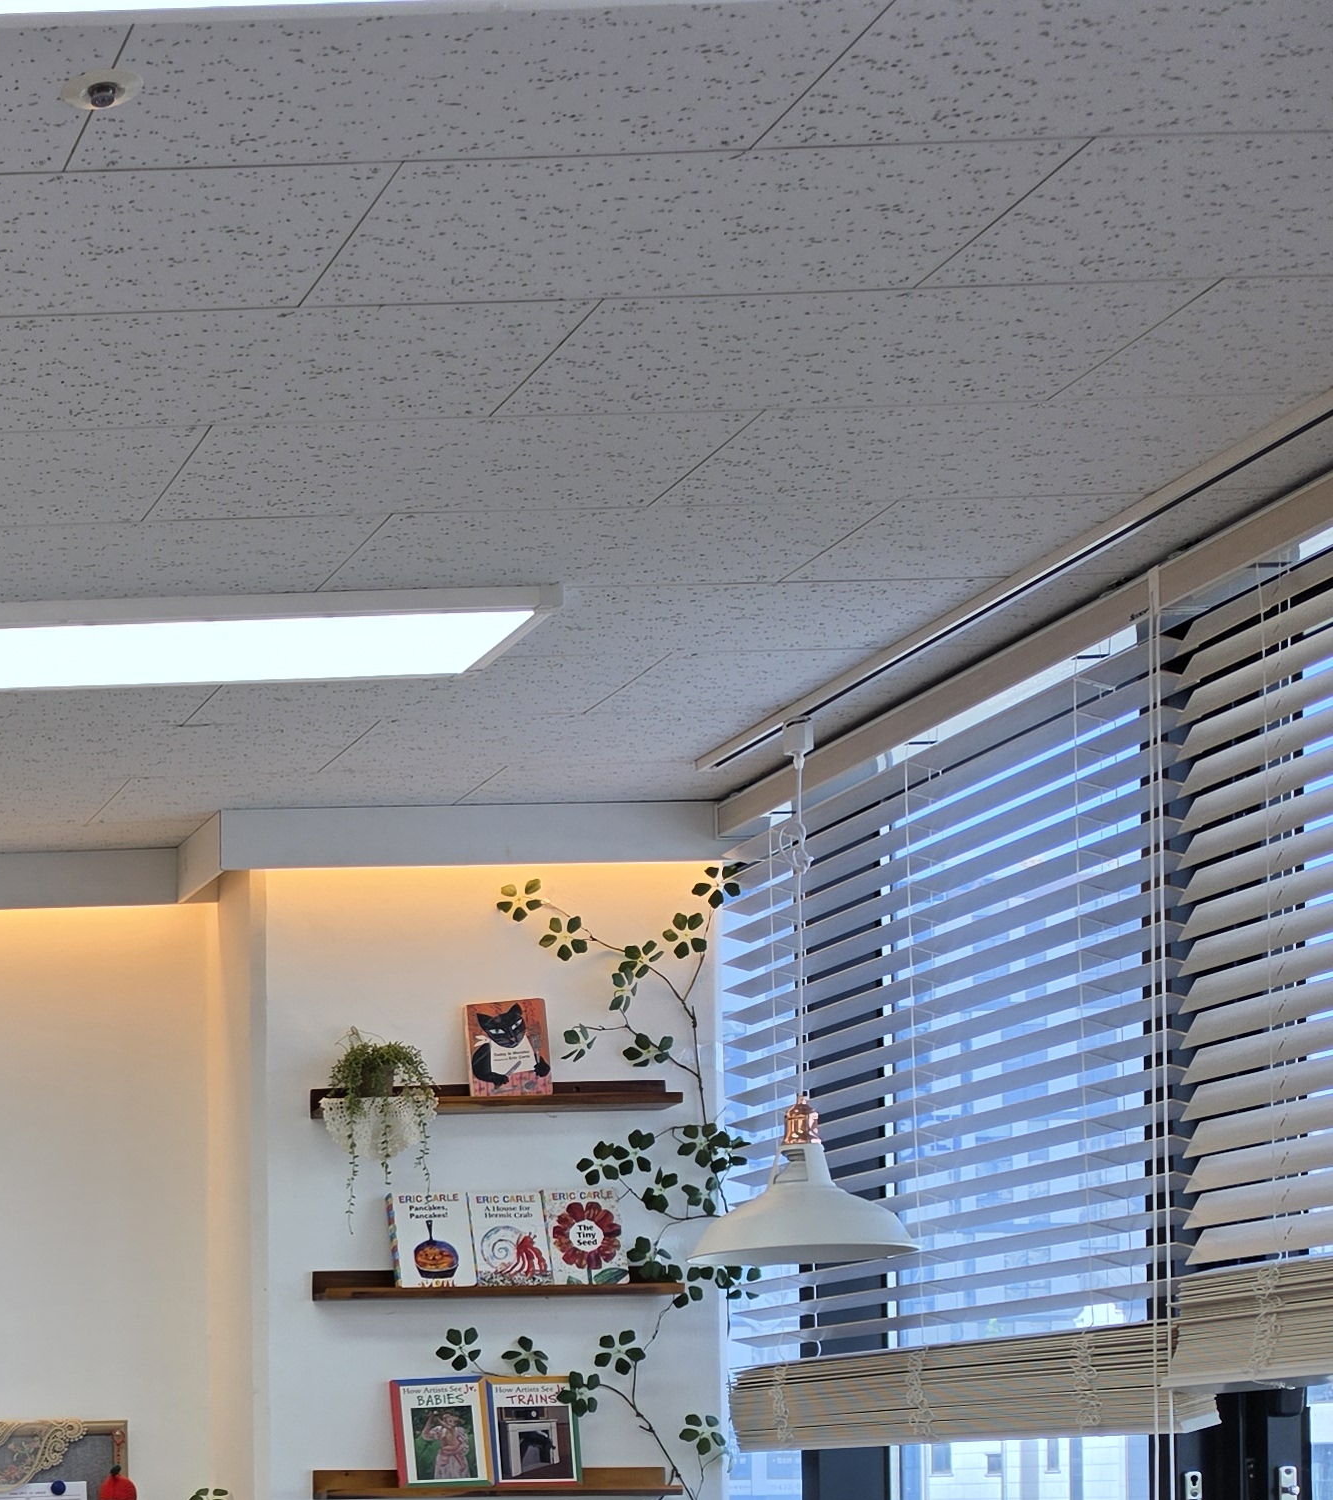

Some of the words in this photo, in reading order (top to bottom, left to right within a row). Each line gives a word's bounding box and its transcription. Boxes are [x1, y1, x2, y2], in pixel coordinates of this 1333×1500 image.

[398, 1195, 423, 1204] ERIC
[424, 1193, 460, 1203] CARLE
[476, 1195, 500, 1204] ERIC
[502, 1195, 536, 1204] CARLE
[552, 1192, 576, 1200] ERIC
[579, 1189, 613, 1200] CARLE
[409, 1211, 448, 1219] Pancakes!
[513, 1211, 533, 1219] Crab
[403, 1387, 421, 1395] How
[423, 1386, 448, 1394] Artists
[463, 1384, 477, 1395] Jr.
[417, 1393, 465, 1406] BABIES
[506, 1395, 558, 1405] TRAINS
